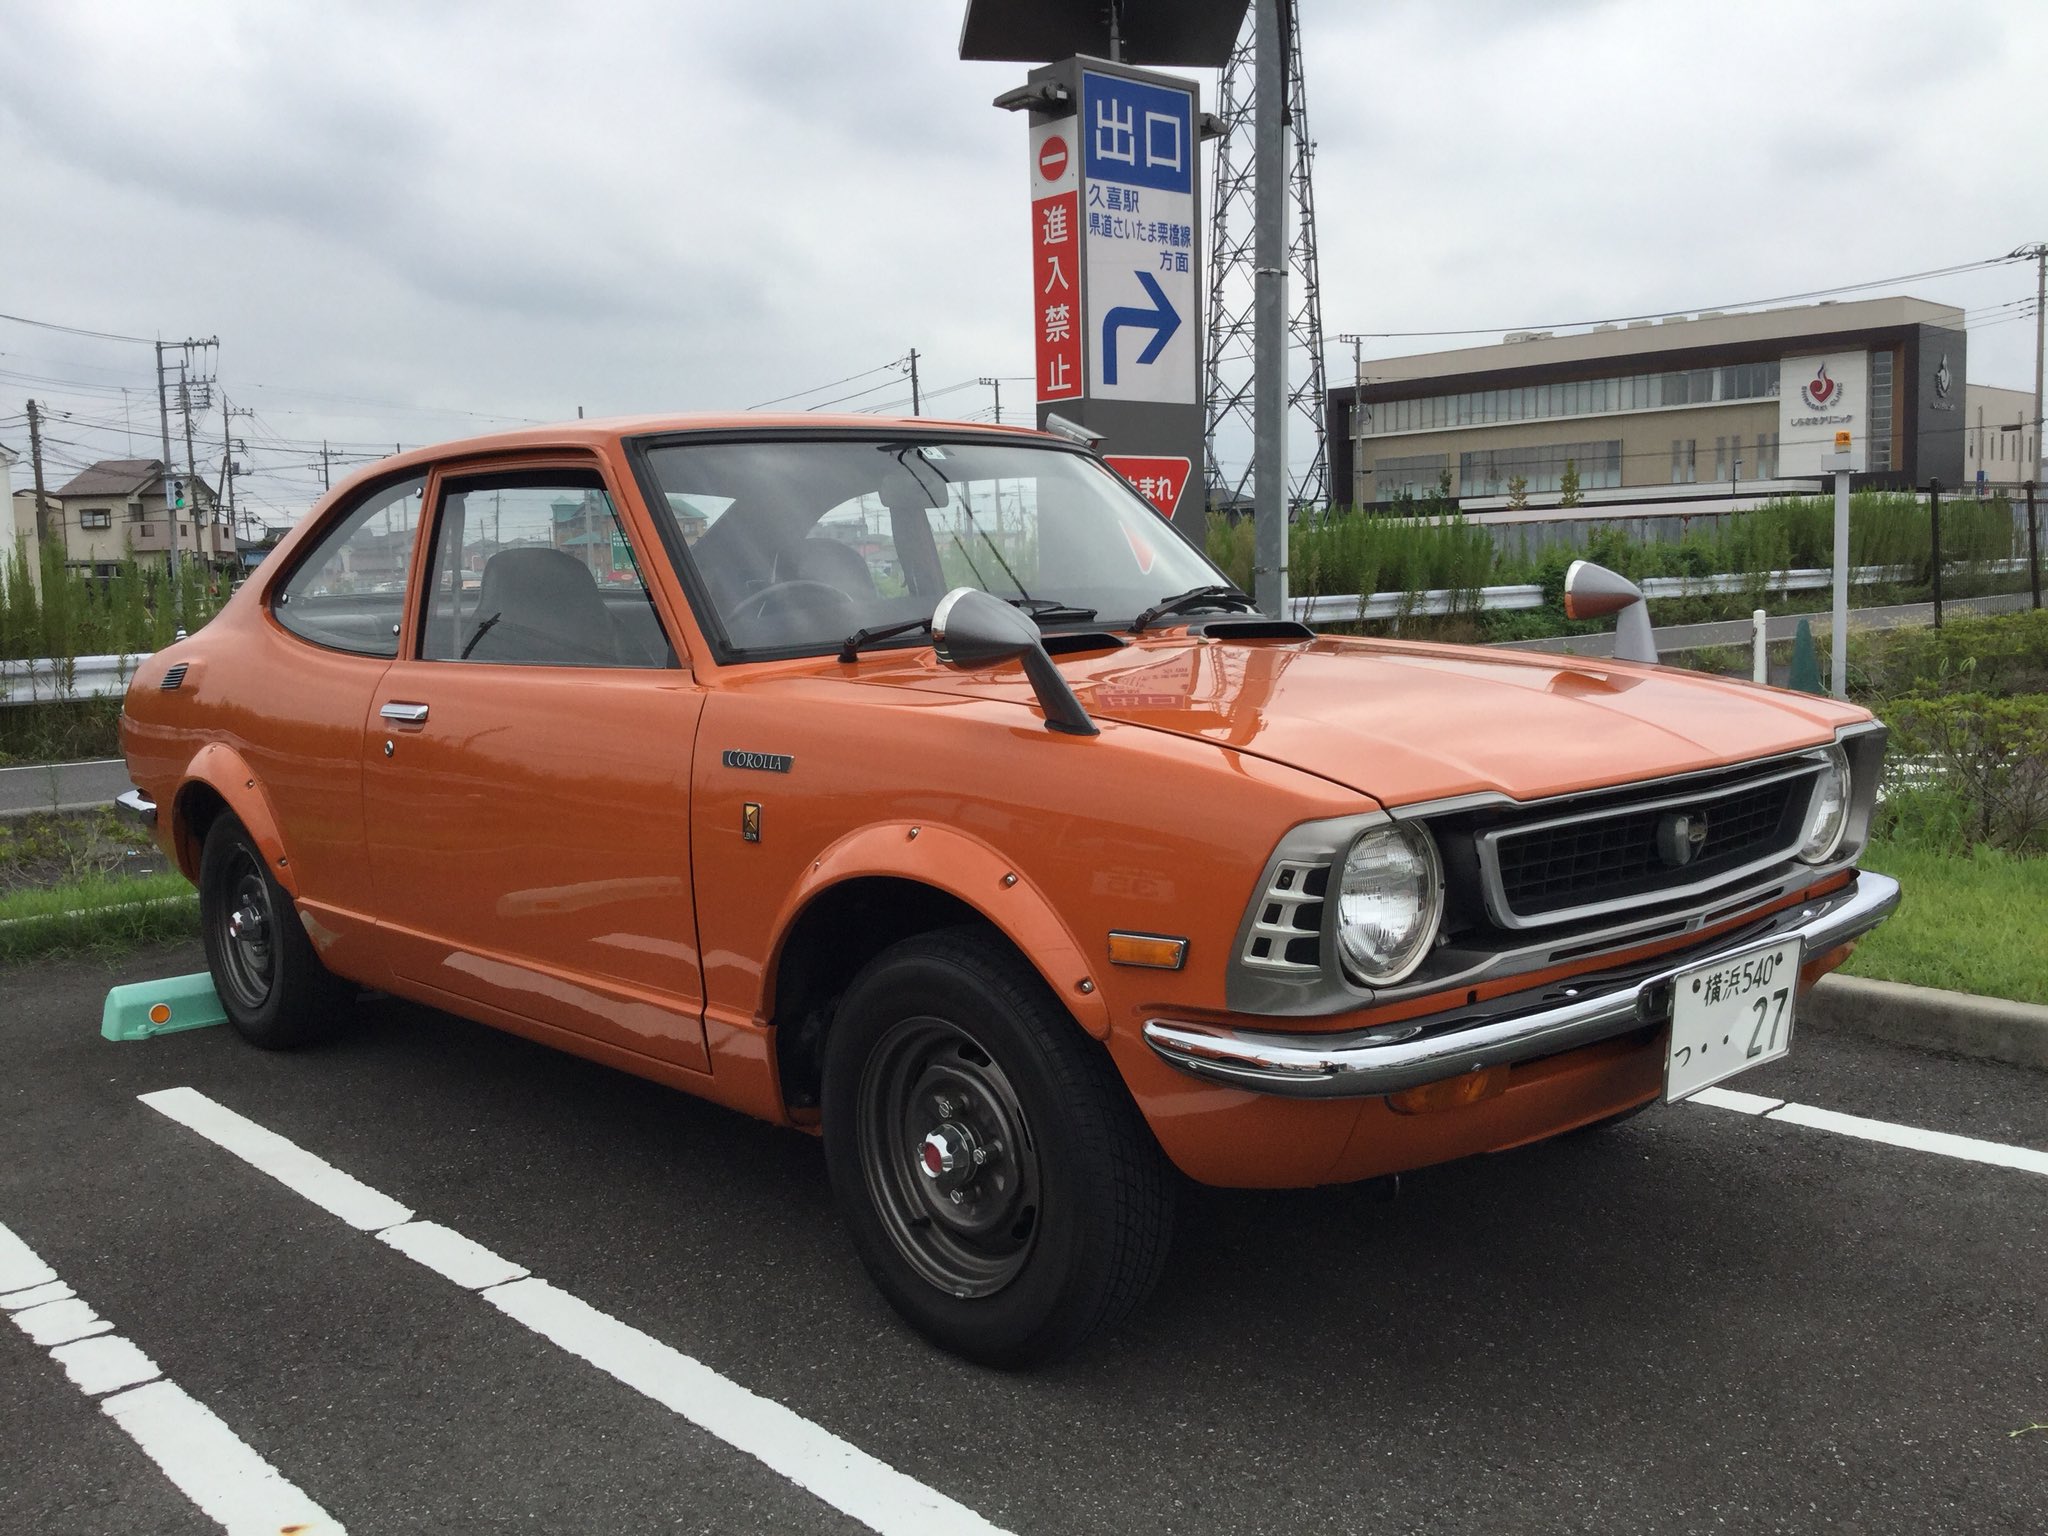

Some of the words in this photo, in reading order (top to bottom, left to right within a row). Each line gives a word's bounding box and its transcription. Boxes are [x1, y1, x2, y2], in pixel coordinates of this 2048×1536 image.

[1096, 98, 1182, 172] 出口
[1088, 184, 1140, 213] 久喜駅
[1088, 212, 1192, 249] 県道さいたま栗橋線
[1160, 250, 1189, 273] 方面
[1042, 204, 1073, 393] 進入禁止
[728, 750, 781, 770] COROLLA
